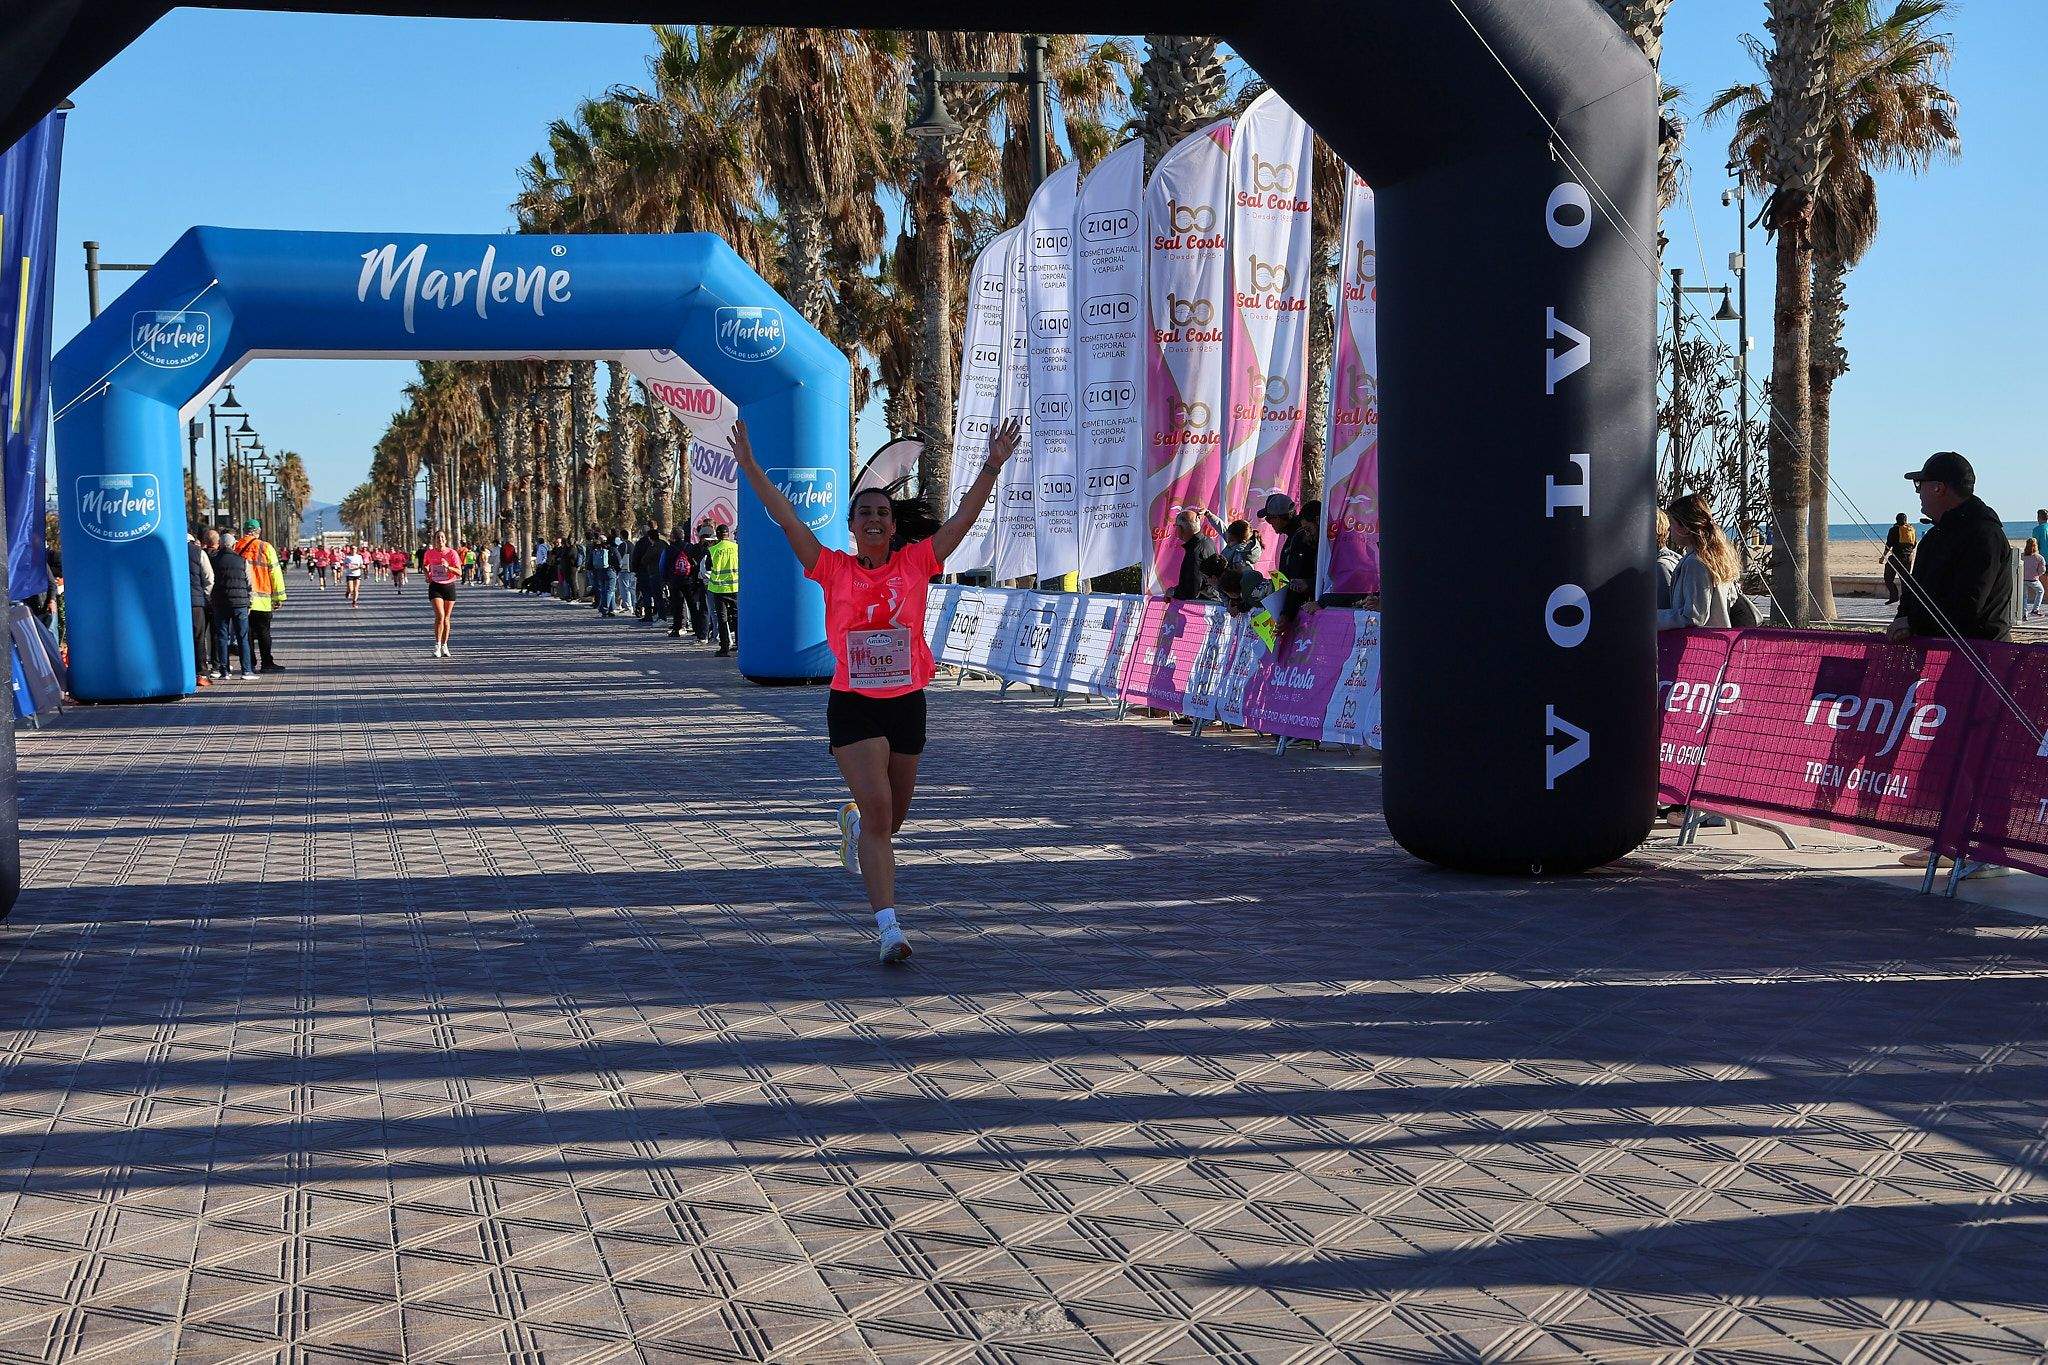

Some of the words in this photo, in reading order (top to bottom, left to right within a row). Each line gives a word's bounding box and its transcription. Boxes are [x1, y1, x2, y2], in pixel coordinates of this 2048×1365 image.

[1237, 191, 1264, 208] Sal
[1267, 193, 1311, 212] Costa
[1088, 217, 1128, 236] ziaja
[1036, 236, 1068, 253] ziaja
[1154, 235, 1182, 250] Sal
[1089, 301, 1130, 320] ziaja
[1236, 292, 1262, 309] Sal
[1265, 293, 1307, 311] Costa
[1039, 318, 1069, 335] ziaja
[1153, 328, 1181, 343] Sal
[652, 382, 716, 415] COSMO
[1089, 388, 1130, 406] ziaja
[1153, 431, 1179, 447] Sal
[692, 440, 738, 484] COSMO
[1088, 473, 1130, 491] ziaja
[1545, 181, 1592, 790] VOLVO
[1020, 625, 1052, 659] ziaja
[1271, 665, 1291, 688] Sal
[1289, 666, 1316, 690] Costa
[1803, 677, 1948, 757] renfe
[1804, 761, 1845, 788] TREN
[1847, 767, 1909, 799] OFICIAL
